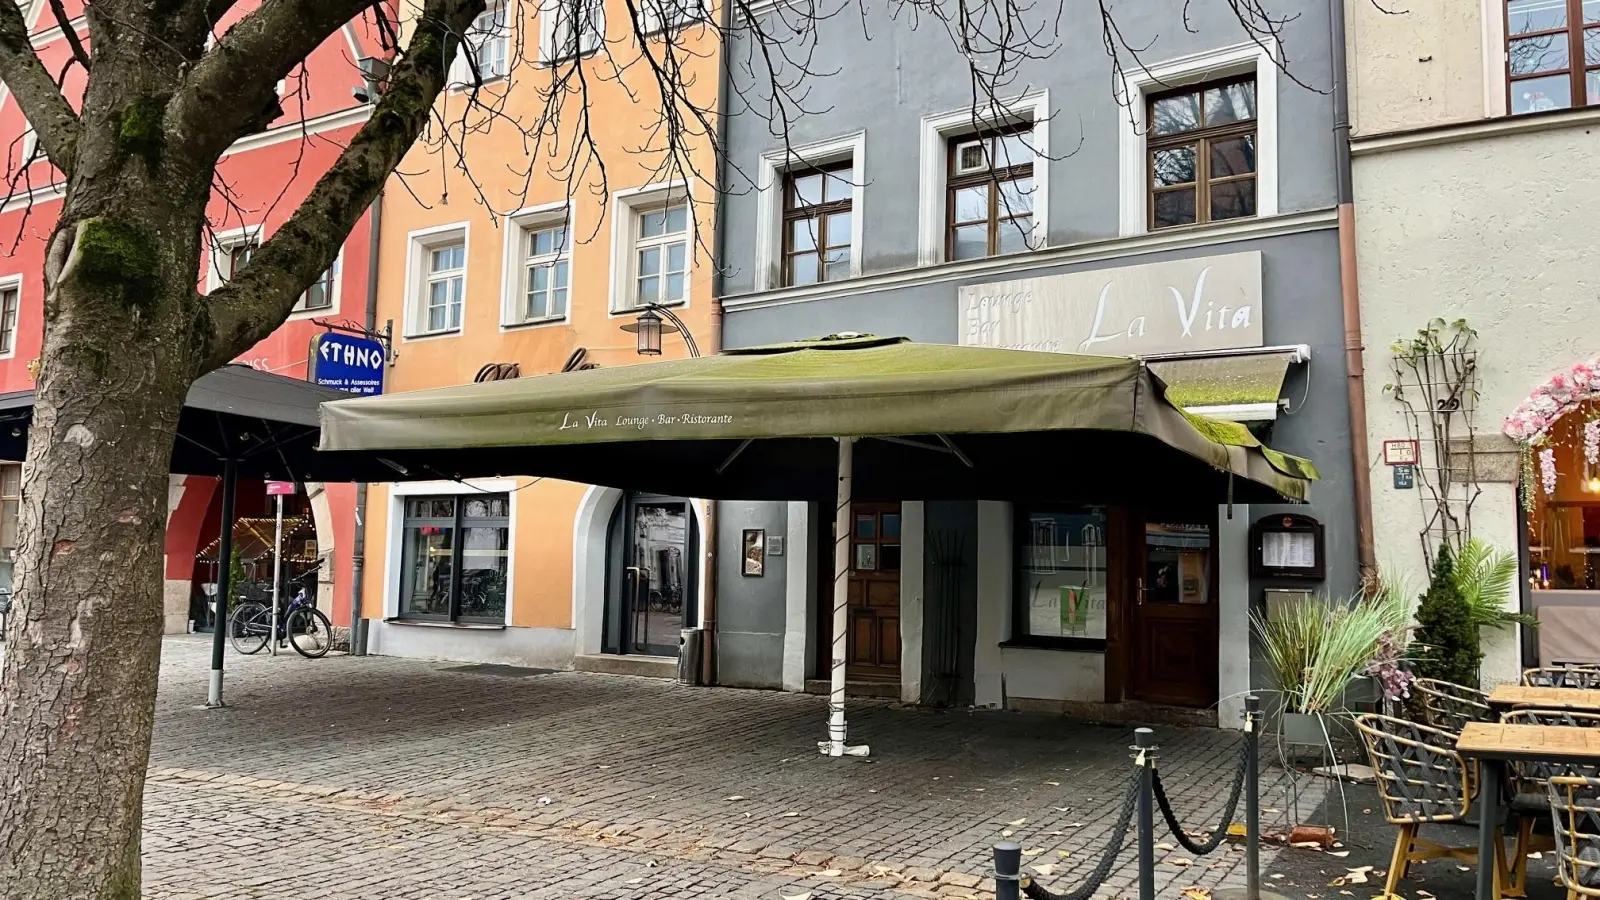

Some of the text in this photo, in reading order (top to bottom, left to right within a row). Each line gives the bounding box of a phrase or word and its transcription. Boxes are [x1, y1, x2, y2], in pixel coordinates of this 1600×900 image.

[965, 290, 1033, 314] Lounge
[1076, 264, 1252, 352] La Vita
[965, 317, 1001, 337] Bar
[320, 340, 382, 369] ETHNO
[318, 378, 380, 386] Schmuck & Assessoires
[558, 410, 733, 431] La Vita Lounge Bar Ristorante
